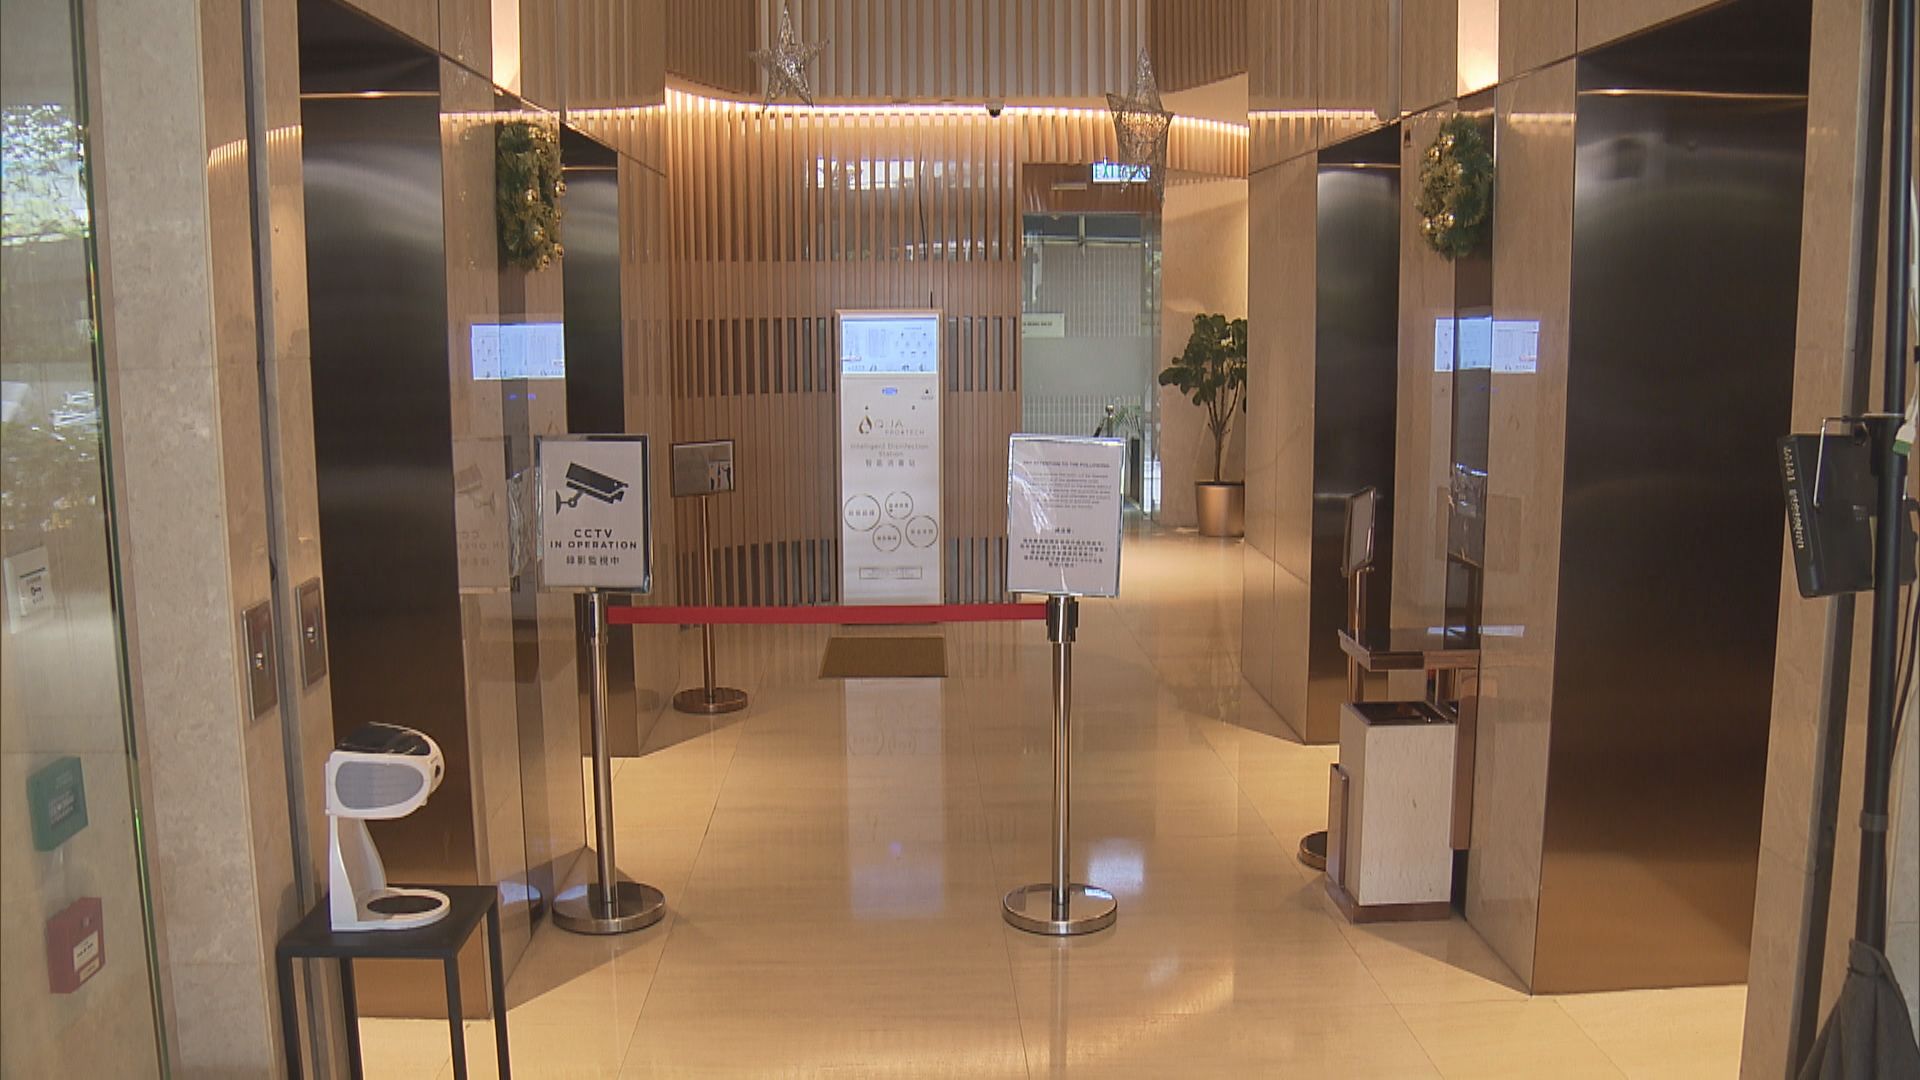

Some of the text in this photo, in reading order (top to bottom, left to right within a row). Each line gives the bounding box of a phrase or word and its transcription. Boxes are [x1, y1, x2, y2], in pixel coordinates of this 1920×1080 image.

[574, 529, 613, 538] CCTV
[550, 541, 637, 550] IN OPERATION
